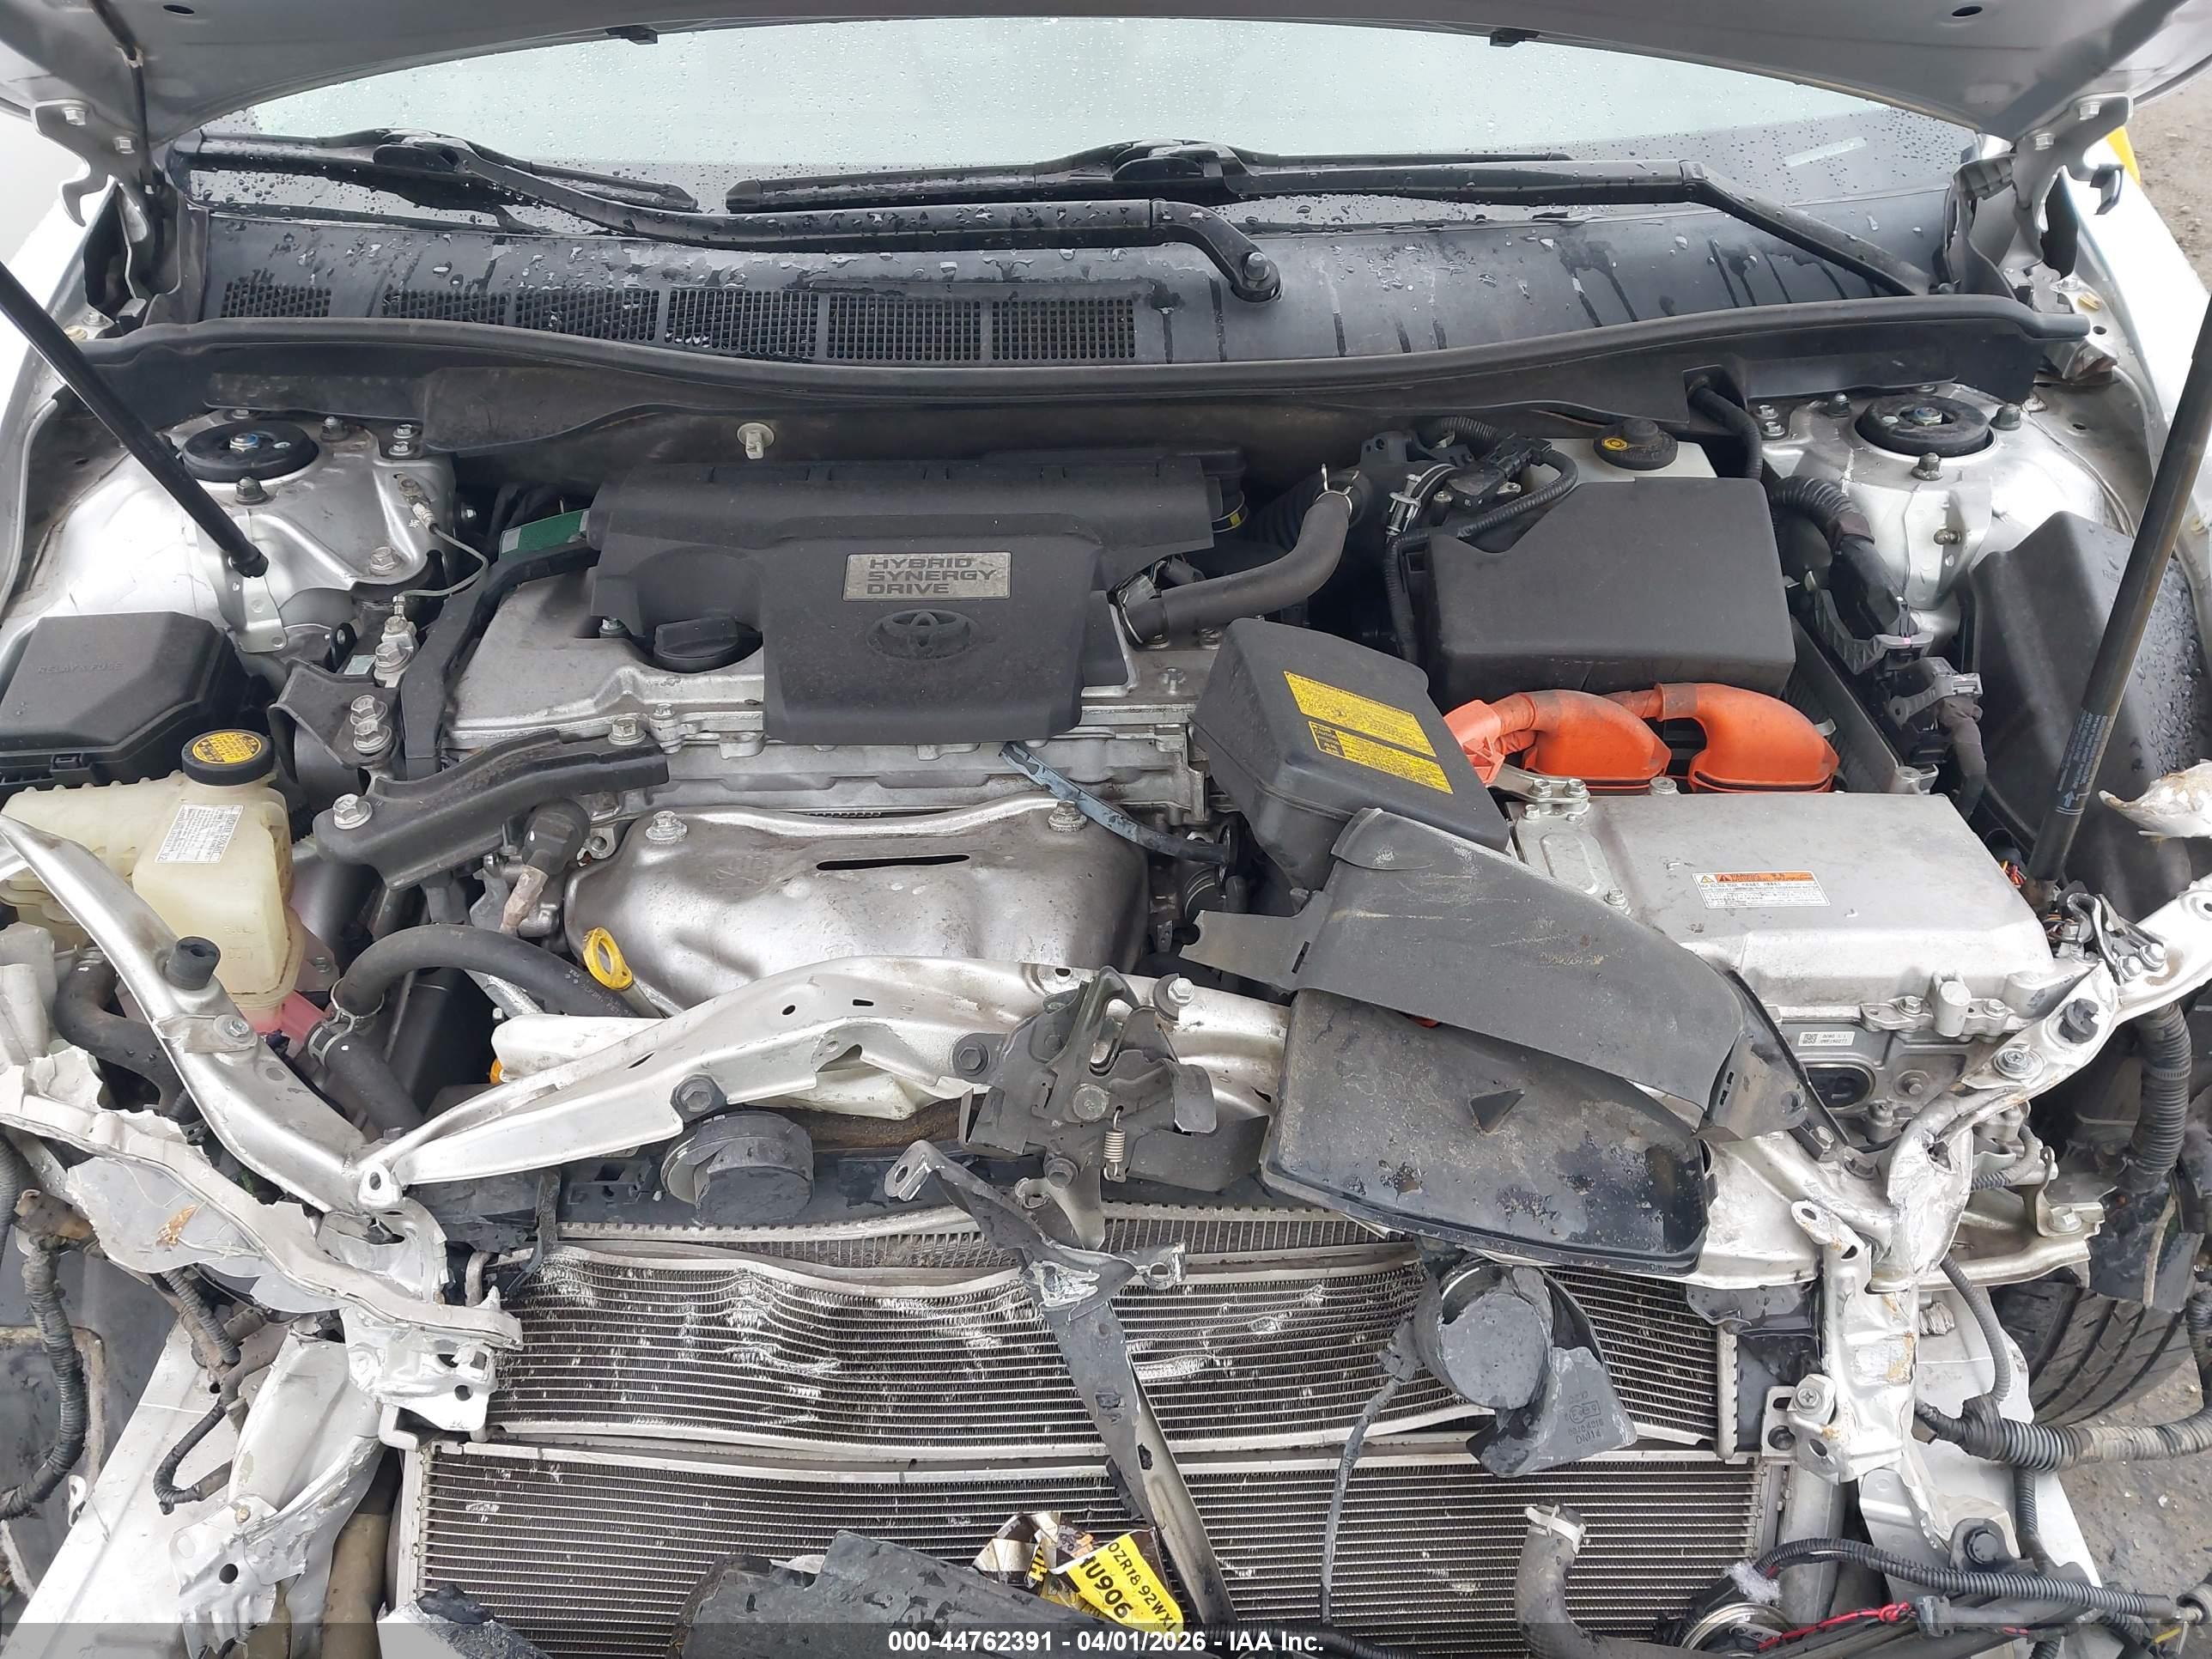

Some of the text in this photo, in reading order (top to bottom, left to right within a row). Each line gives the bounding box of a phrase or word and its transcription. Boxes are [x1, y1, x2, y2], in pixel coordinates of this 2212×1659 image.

[870, 557, 972, 569] HYBRID
[867, 569, 997, 581] SYNERGY
[866, 583, 950, 594] DRIVE
